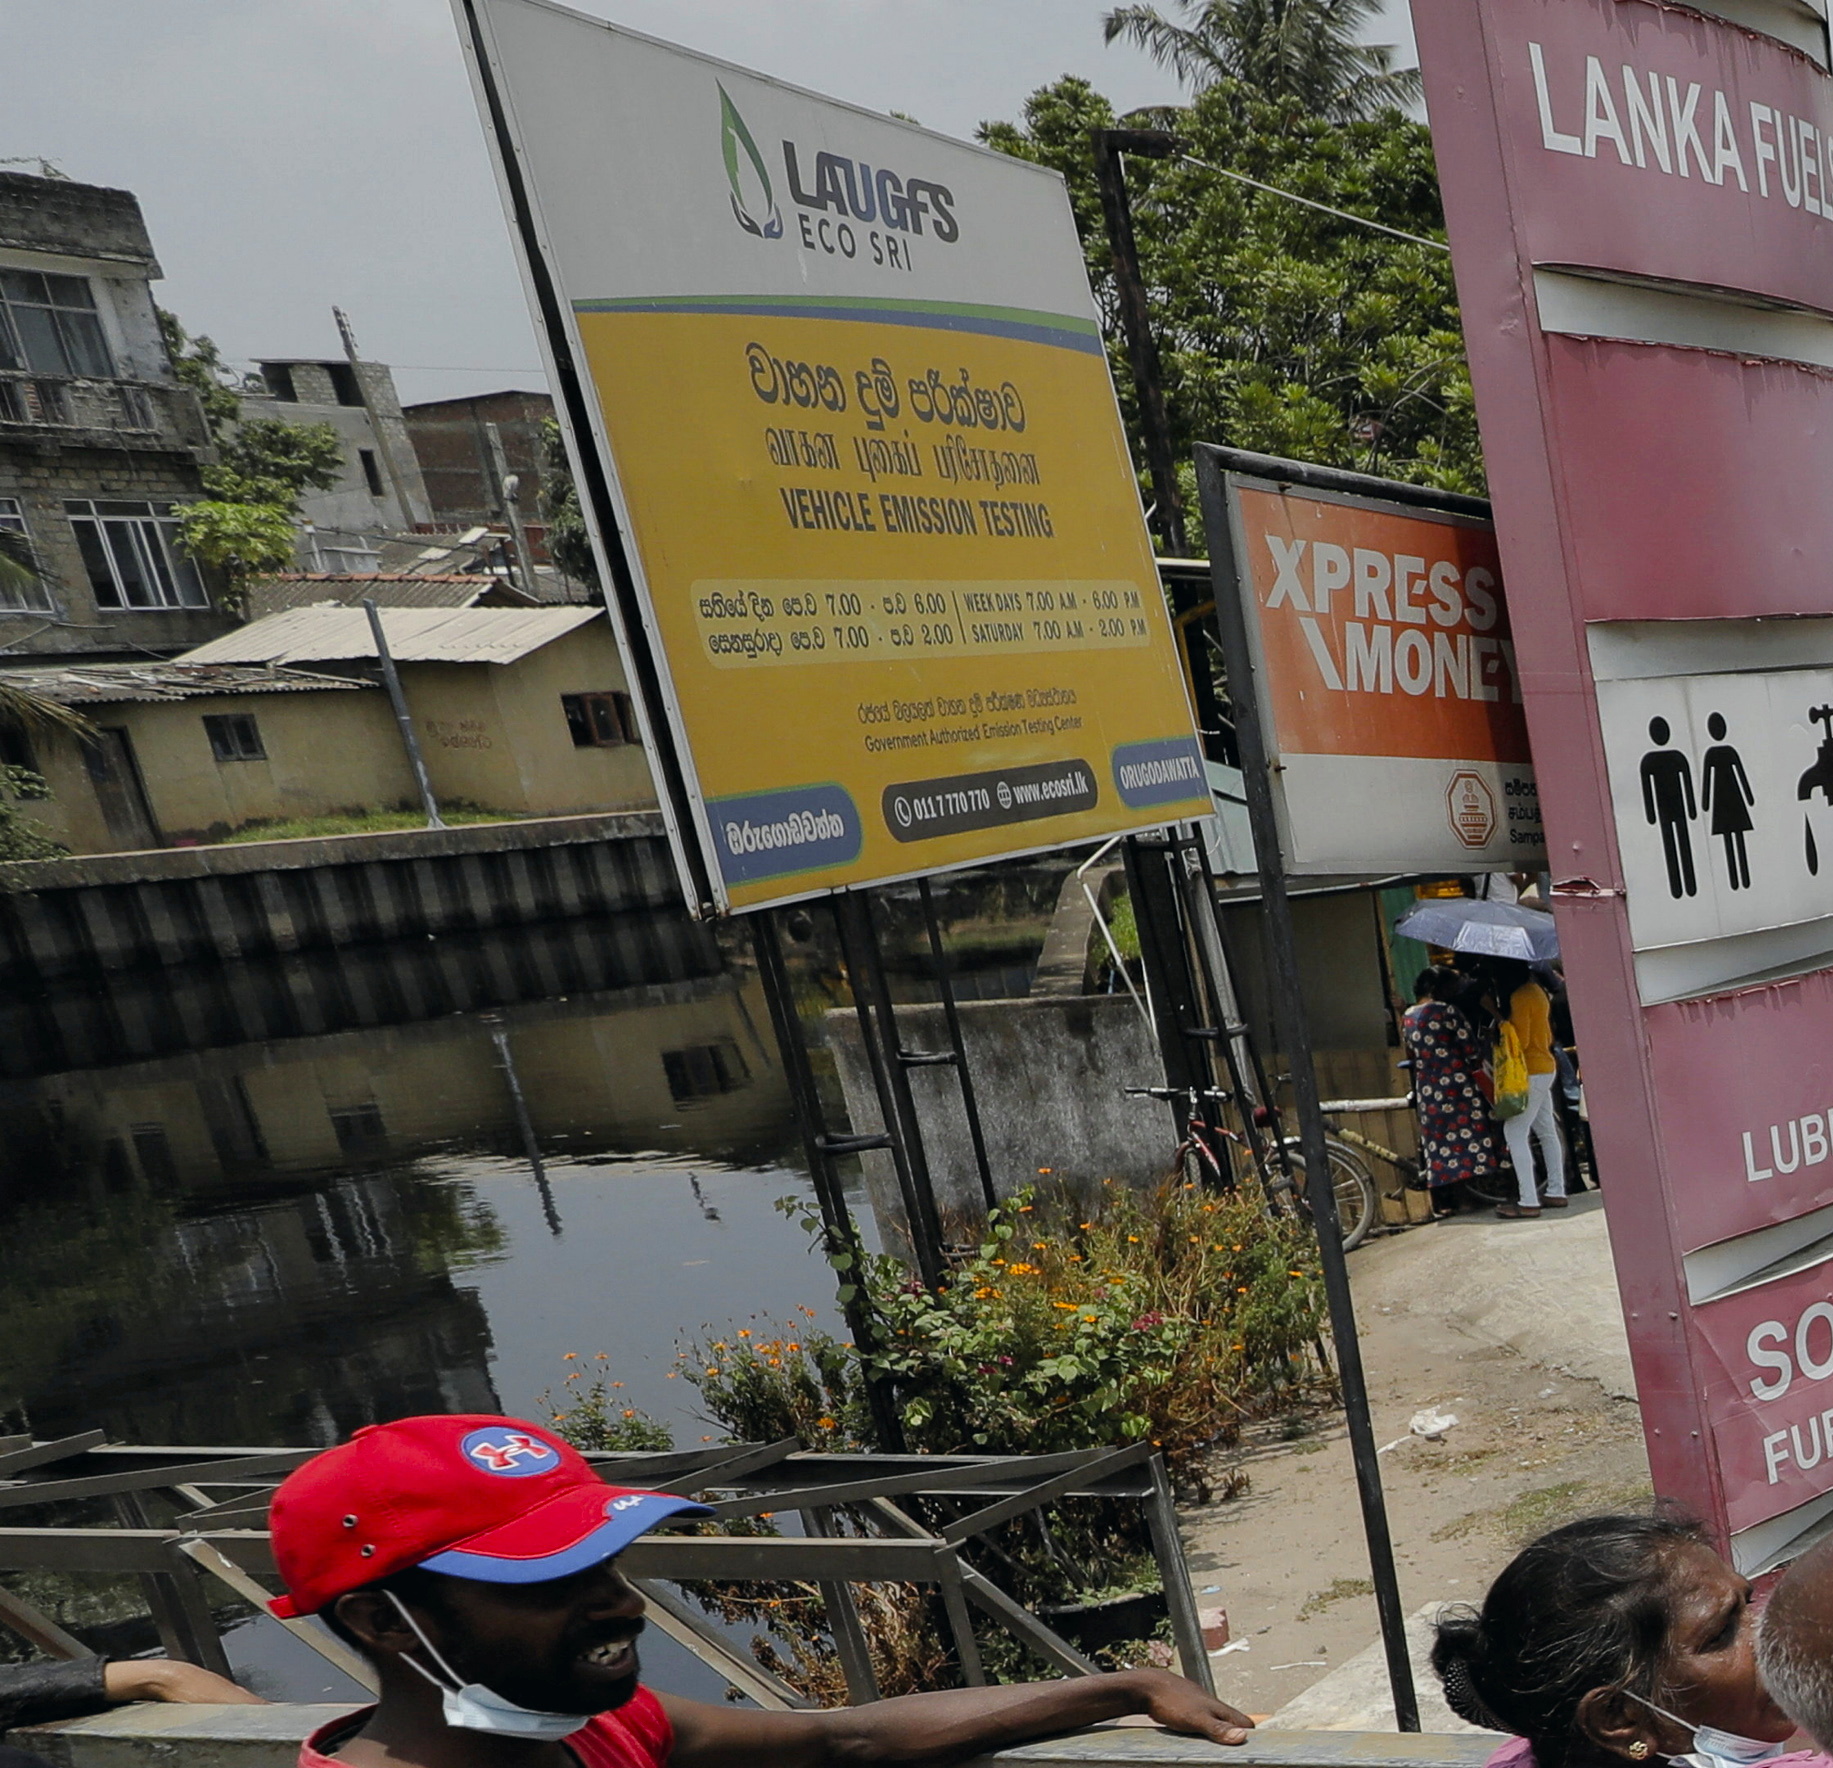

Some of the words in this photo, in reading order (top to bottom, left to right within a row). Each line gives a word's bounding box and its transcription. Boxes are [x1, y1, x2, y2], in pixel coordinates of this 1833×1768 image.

[1528, 41, 1749, 193] LANKA
[781, 139, 959, 244] LAUGFS
[797, 212, 856, 259] ECO
[873, 228, 913, 272] SRI
[780, 488, 877, 531] VEHICLE
[879, 494, 978, 535] EMISSION
[980, 500, 1055, 538] TESTING
[825, 593, 862, 616] 7.00
[915, 593, 946, 614] 6.00
[1026, 591, 1054, 611] 7.00
[1092, 590, 1118, 609] 6.00
[1265, 533, 1495, 631] XPRESS
[834, 625, 869, 649] 7.00
[921, 624, 953, 645] 2.00
[972, 623, 1024, 643] SATURDAY
[1033, 620, 1060, 641] 7.00
[1099, 618, 1124, 638] 2.00
[865, 731, 929, 753] Government
[930, 725, 981, 745] Authorized
[984, 719, 1021, 739] Emission
[1021, 717, 1054, 736] Testing
[1055, 715, 1082, 731] Center
[1013, 772, 1089, 805] www.ecosri.lk
[1120, 755, 1200, 791] ORUGODAWATTA
